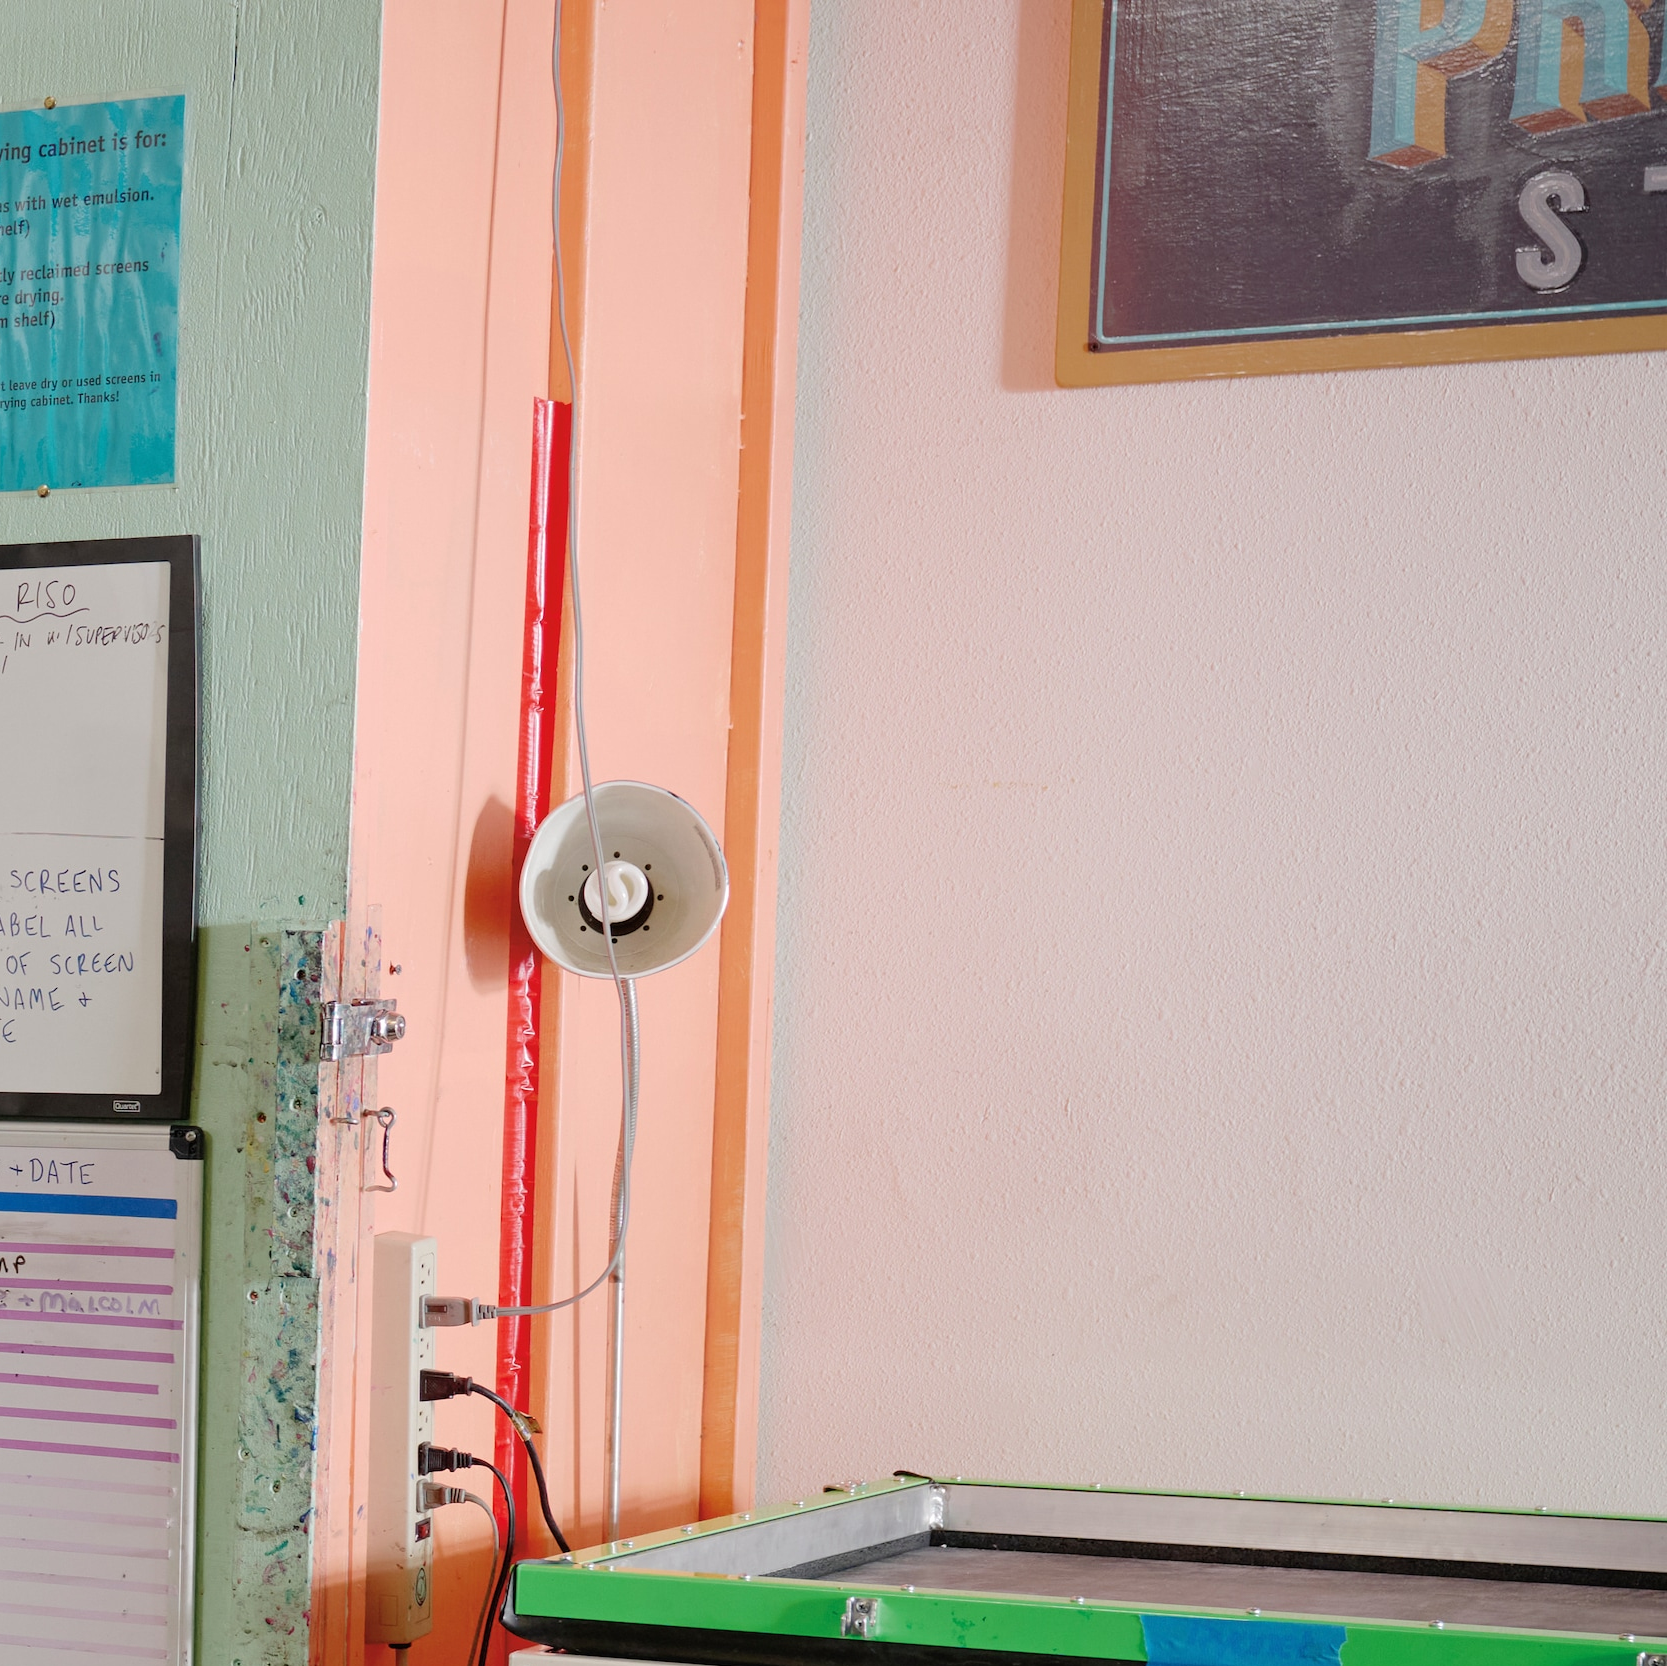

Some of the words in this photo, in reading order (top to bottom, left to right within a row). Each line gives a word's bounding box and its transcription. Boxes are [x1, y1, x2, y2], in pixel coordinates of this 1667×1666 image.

[39, 135, 106, 157] cabinet
[112, 133, 128, 150] is
[135, 130, 167, 149] for:
[14, 195, 46, 212] with
[52, 193, 78, 209] wet
[83, 188, 155, 206] emulsion.
[20, 262, 90, 280] reclaimed
[95, 260, 149, 275] screens
[14, 287, 64, 306] drying.
[14, 310, 55, 330] shelf)
[9, 379, 37, 391] leave
[41, 377, 58, 391] dry
[61, 378, 73, 388] or
[76, 375, 102, 387] used
[105, 372, 146, 385] screens
[150, 371, 161, 383] in
[31, 394, 74, 407] cabinet.
[77, 390, 119, 404] Thanks!
[17, 580, 76, 614] RISO
[10, 869, 122, 894] SCREENS
[65, 915, 104, 937] ALL
[6, 951, 32, 976] OF
[52, 951, 135, 975] SCREEN
[30, 1158, 95, 1185] DATE
